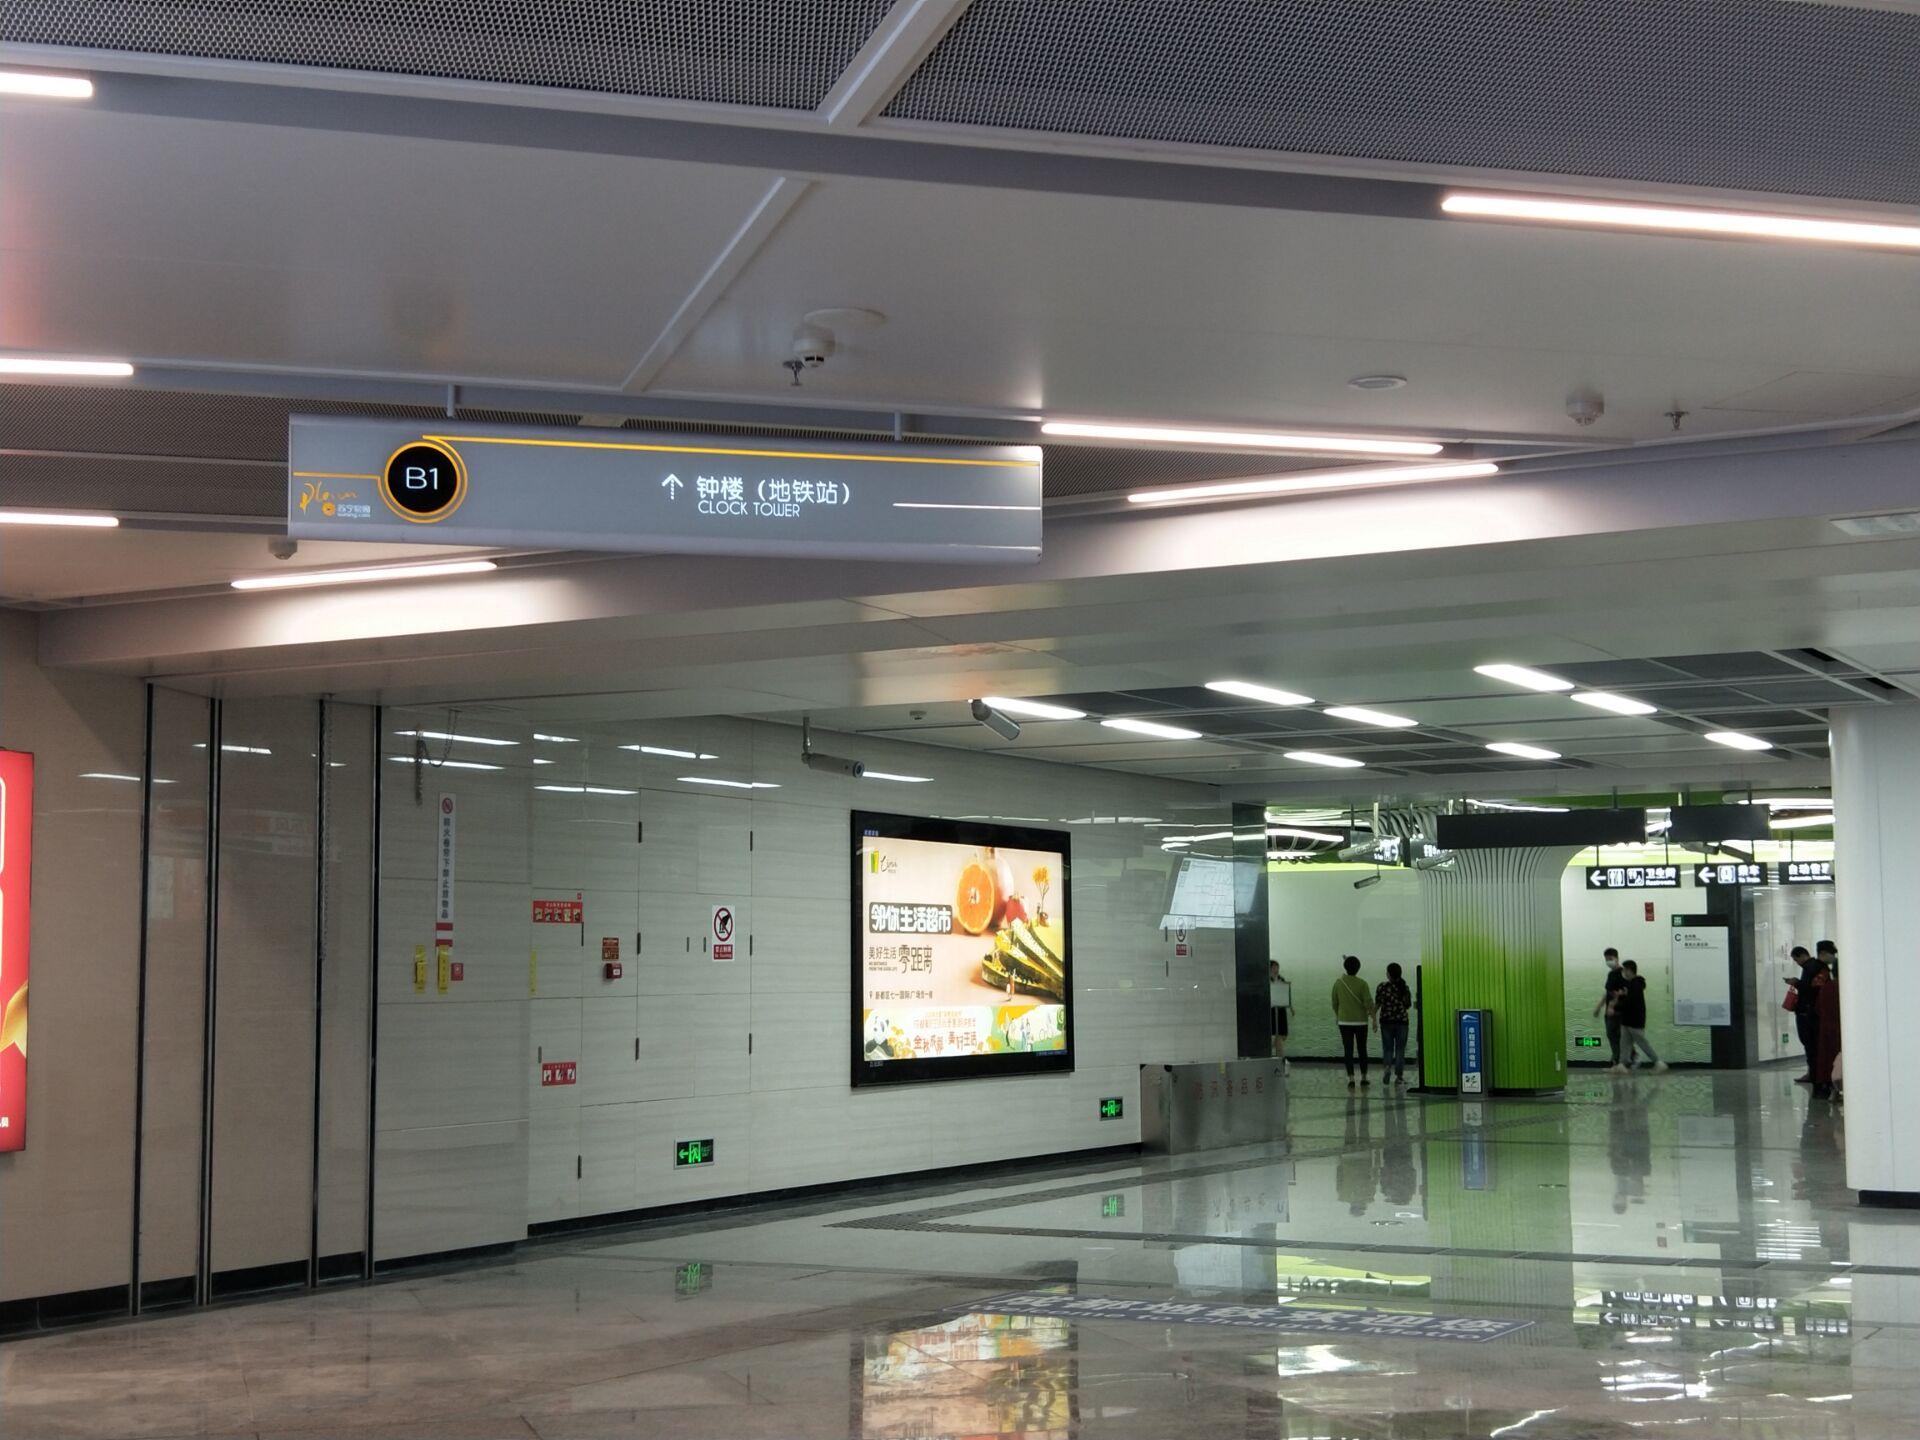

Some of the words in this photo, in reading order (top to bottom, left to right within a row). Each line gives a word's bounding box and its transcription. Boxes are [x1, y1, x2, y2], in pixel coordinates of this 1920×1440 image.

[405, 466, 439, 491] B1
[696, 475, 851, 505] 钟楼（地铁站）
[698, 500, 748, 516] CLOCK
[753, 502, 801, 518] TOWER
[899, 944, 933, 974] 零距离
[988, 1295, 1514, 1333] 成都地铁欢迎您
[1361, 1326, 1481, 1339] Metro
